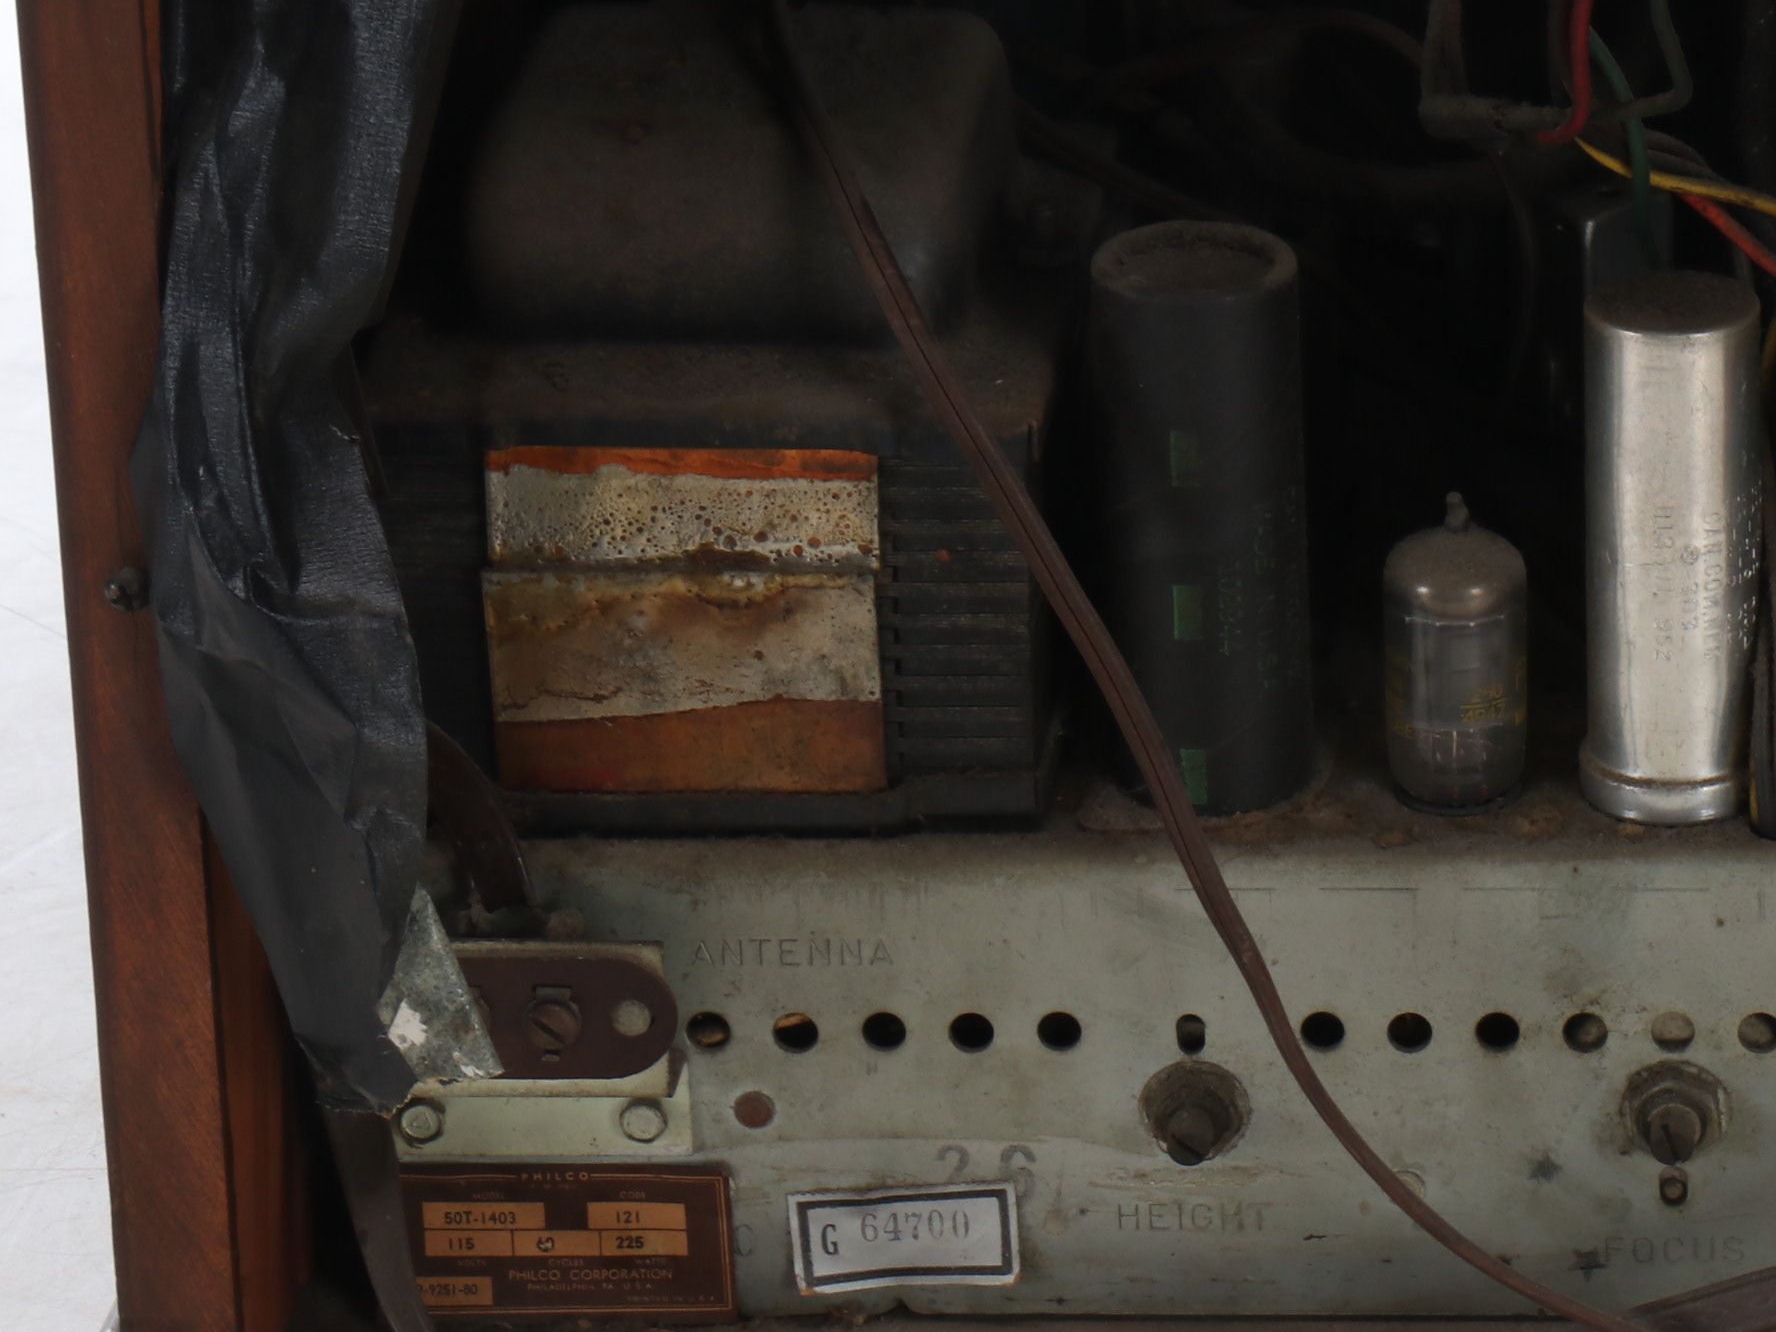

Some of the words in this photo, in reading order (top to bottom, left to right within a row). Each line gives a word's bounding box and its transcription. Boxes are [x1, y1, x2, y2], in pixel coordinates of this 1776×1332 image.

[692, 938, 894, 966] ANTENNA
[520, 1171, 590, 1182] PHILCO
[443, 1211, 518, 1226] 50T-1403
[615, 1211, 641, 1224] 121
[1117, 1202, 1274, 1232] HEIGHT
[820, 1223, 839, 1256] G
[859, 1209, 971, 1243] 64700
[448, 1237, 476, 1251] 115
[614, 1236, 645, 1250] 225
[1604, 1235, 1746, 1264] FOCUS
[508, 1269, 561, 1281] PHILCO
[569, 1268, 673, 1281] CORPORATION
